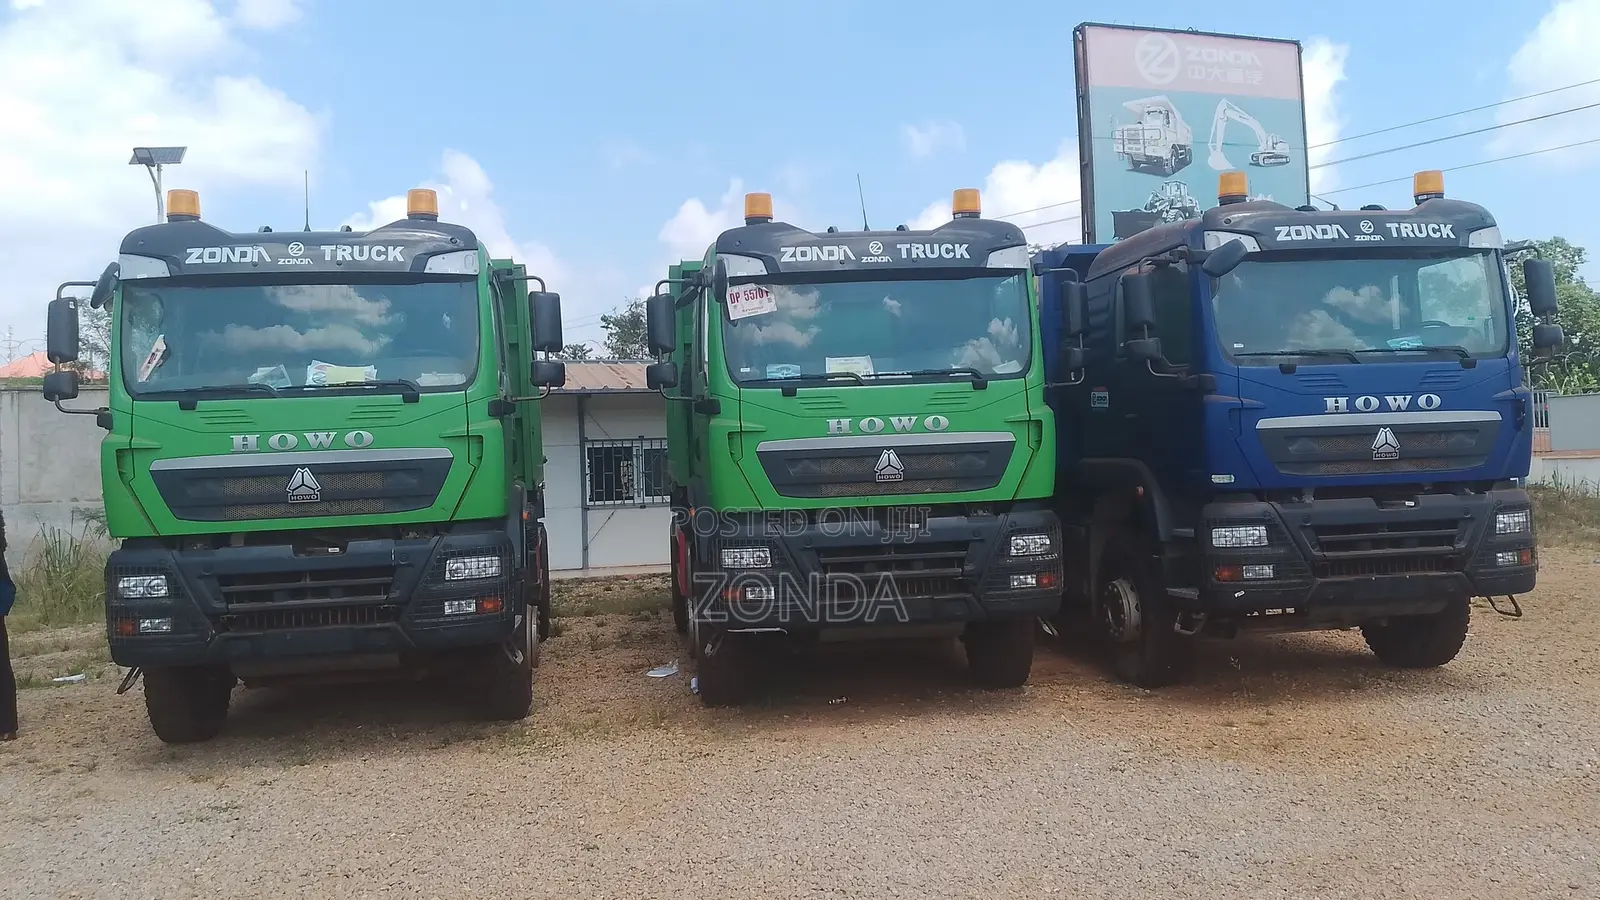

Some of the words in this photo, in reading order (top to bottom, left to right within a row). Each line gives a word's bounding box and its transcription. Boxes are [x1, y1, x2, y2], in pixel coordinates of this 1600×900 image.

[1185, 46, 1264, 68] ZONDA
[1274, 223, 1351, 242] ZONDA
[1386, 222, 1457, 240] TRUCK
[1354, 234, 1385, 242] ZONDA
[185, 245, 272, 264] ZONDA
[320, 244, 405, 262] TRUCK
[780, 244, 857, 263] ZONDA
[897, 243, 971, 259] TRUCK
[860, 255, 893, 263] ZONDA
[729, 291, 741, 305] DP
[1323, 393, 1442, 413] HOWO
[826, 415, 950, 435] HOWO
[229, 430, 375, 452] HOWO
[291, 493, 318, 501] HOWO
